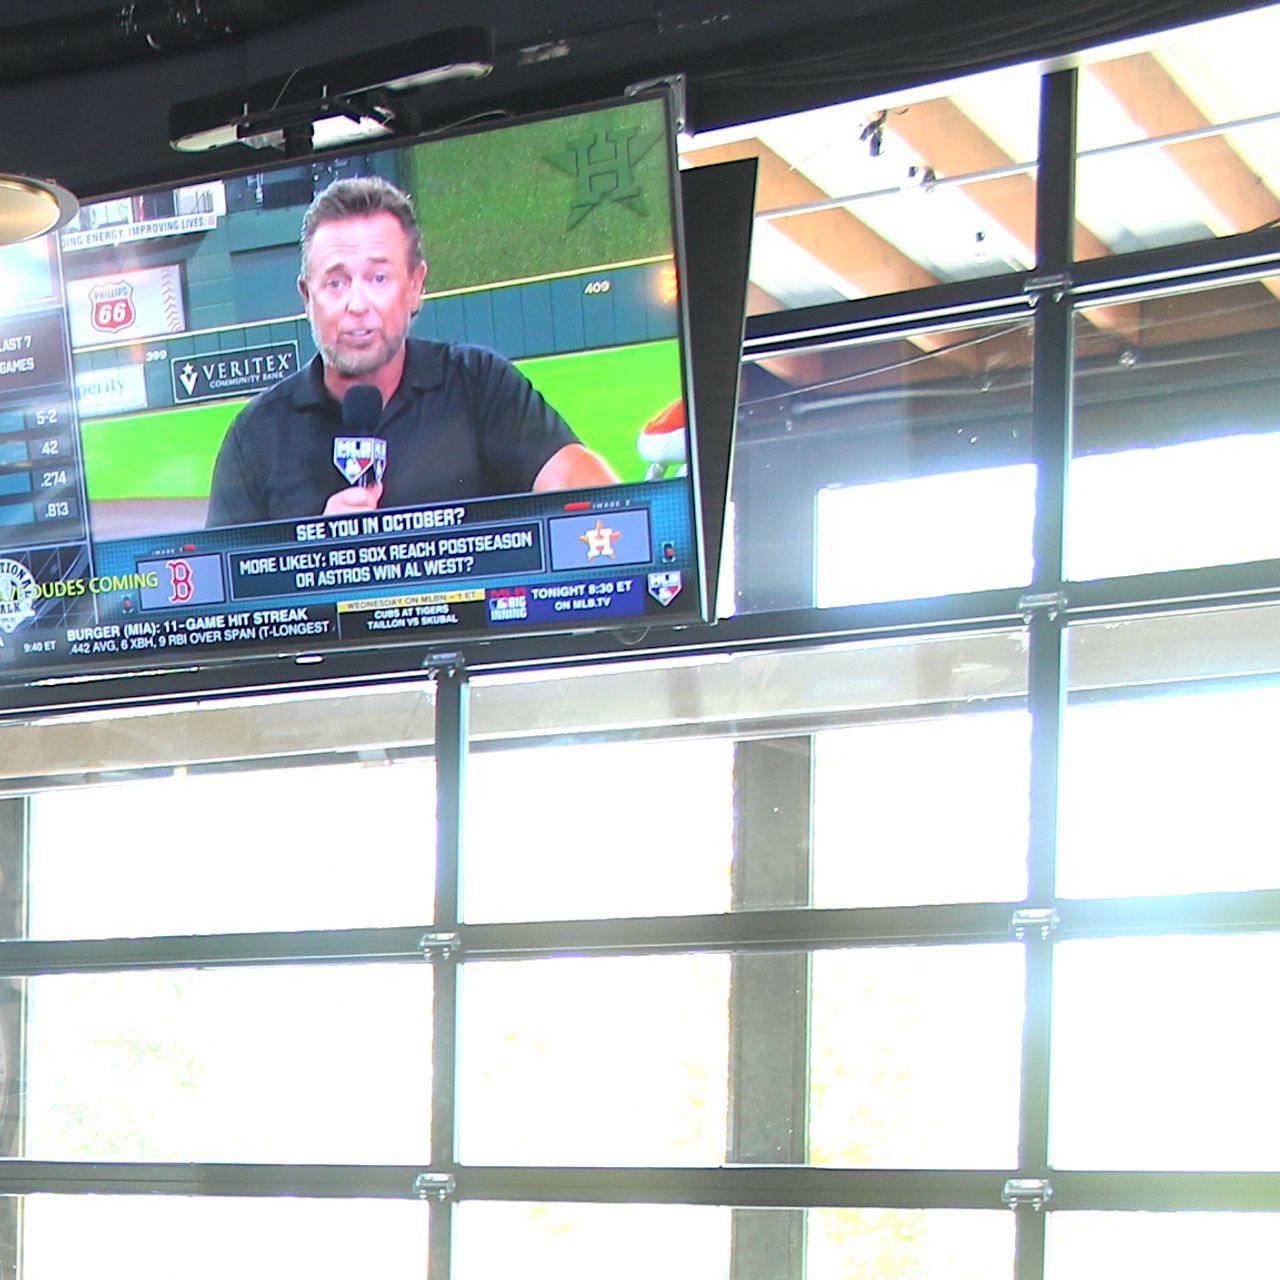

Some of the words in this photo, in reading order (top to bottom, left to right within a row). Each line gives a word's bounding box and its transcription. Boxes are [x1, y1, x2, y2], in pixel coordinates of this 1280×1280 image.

[128, 220, 180, 238] IMPROVING
[181, 216, 206, 230] LIVES.
[94, 286, 128, 301] PHILLIPS
[584, 281, 611, 294] 409
[98, 304, 127, 325] 66
[24, 336, 32, 349] 7
[146, 350, 168, 362] 399
[202, 353, 290, 381] VERITEX
[209, 373, 261, 389] COMMUNITY
[262, 371, 286, 384] BANK
[36, 409, 58, 425] 5-2
[42, 441, 59, 455] 42
[41, 471, 67, 488] .274
[44, 502, 69, 518] .813
[296, 523, 326, 542] SEE
[328, 519, 360, 538] YOU
[362, 516, 380, 534] IN
[382, 507, 465, 532] OCTOBER?
[240, 558, 278, 576] MORE
[279, 553, 327, 572] LIKELY:
[329, 549, 357, 567] RED
[358, 546, 388, 564] SOX
[390, 541, 436, 561] REACH
[438, 531, 533, 556] POSTSEASON
[295, 572, 316, 588] OR
[318, 567, 371, 586] ASTROS
[373, 563, 402, 582] WIN
[404, 561, 422, 578] AL
[424, 556, 475, 577] WEST?
[650, 572, 679, 585] MLB
[30, 582, 86, 600] DUDES
[88, 572, 160, 594] COMING
[532, 584, 587, 600] TONIGHT
[589, 582, 614, 595] 8:30
[615, 580, 633, 593] ET
[345, 597, 403, 610] WEDNESDAY
[405, 596, 419, 606] ON
[555, 600, 572, 611] ON
[573, 596, 611, 611] MLB.TV
[374, 609, 400, 620] CUBS
[401, 608, 415, 618] AT
[415, 604, 450, 616] TIGERS
[67, 624, 122, 642] BURGER
[124, 621, 161, 640] (MIA):
[164, 613, 225, 633] 11-GAME
[228, 613, 249, 627] HIT
[252, 608, 308, 626] STREAK
[367, 619, 406, 631] TAILLON
[407, 617, 420, 628] VS
[420, 615, 458, 627] SKUBAL
[69, 642, 90, 655] .442
[92, 639, 119, 654] AVG,
[121, 638, 128, 650] 6
[129, 636, 157, 651] XBH,
[159, 635, 166, 648] 9
[168, 632, 188, 646] RBI
[189, 629, 223, 645] OVER
[225, 626, 256, 641] SPAN
[258, 620, 329, 641] (T-LONGEST
[24, 642, 44, 653] 9:40
[44, 640, 57, 652] ET
